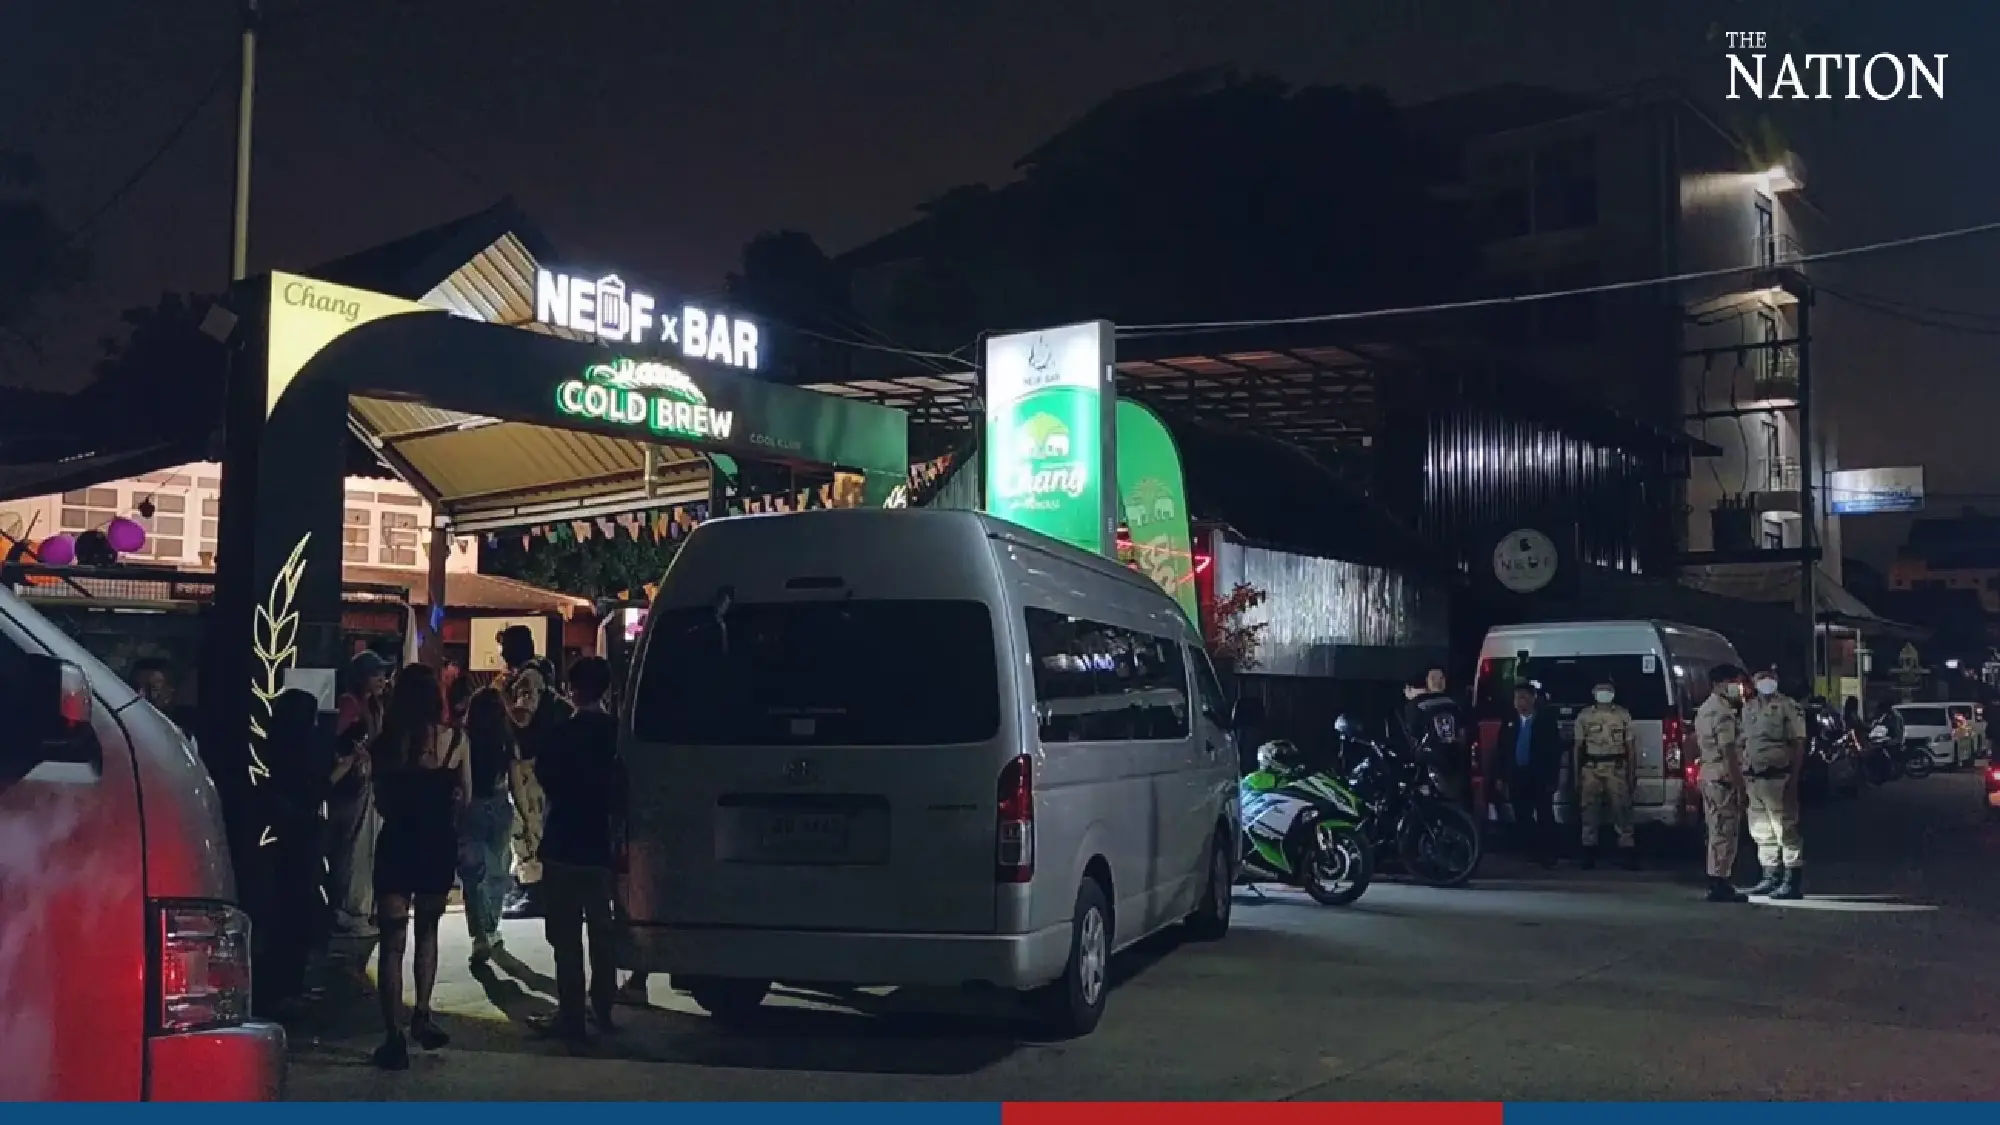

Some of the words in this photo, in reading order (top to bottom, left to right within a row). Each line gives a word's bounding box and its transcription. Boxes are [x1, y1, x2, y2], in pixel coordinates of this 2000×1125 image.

[283, 281, 361, 322] Chang
[682, 305, 759, 370] BAR
[557, 379, 647, 424] COLD
[650, 396, 733, 440] BREW
